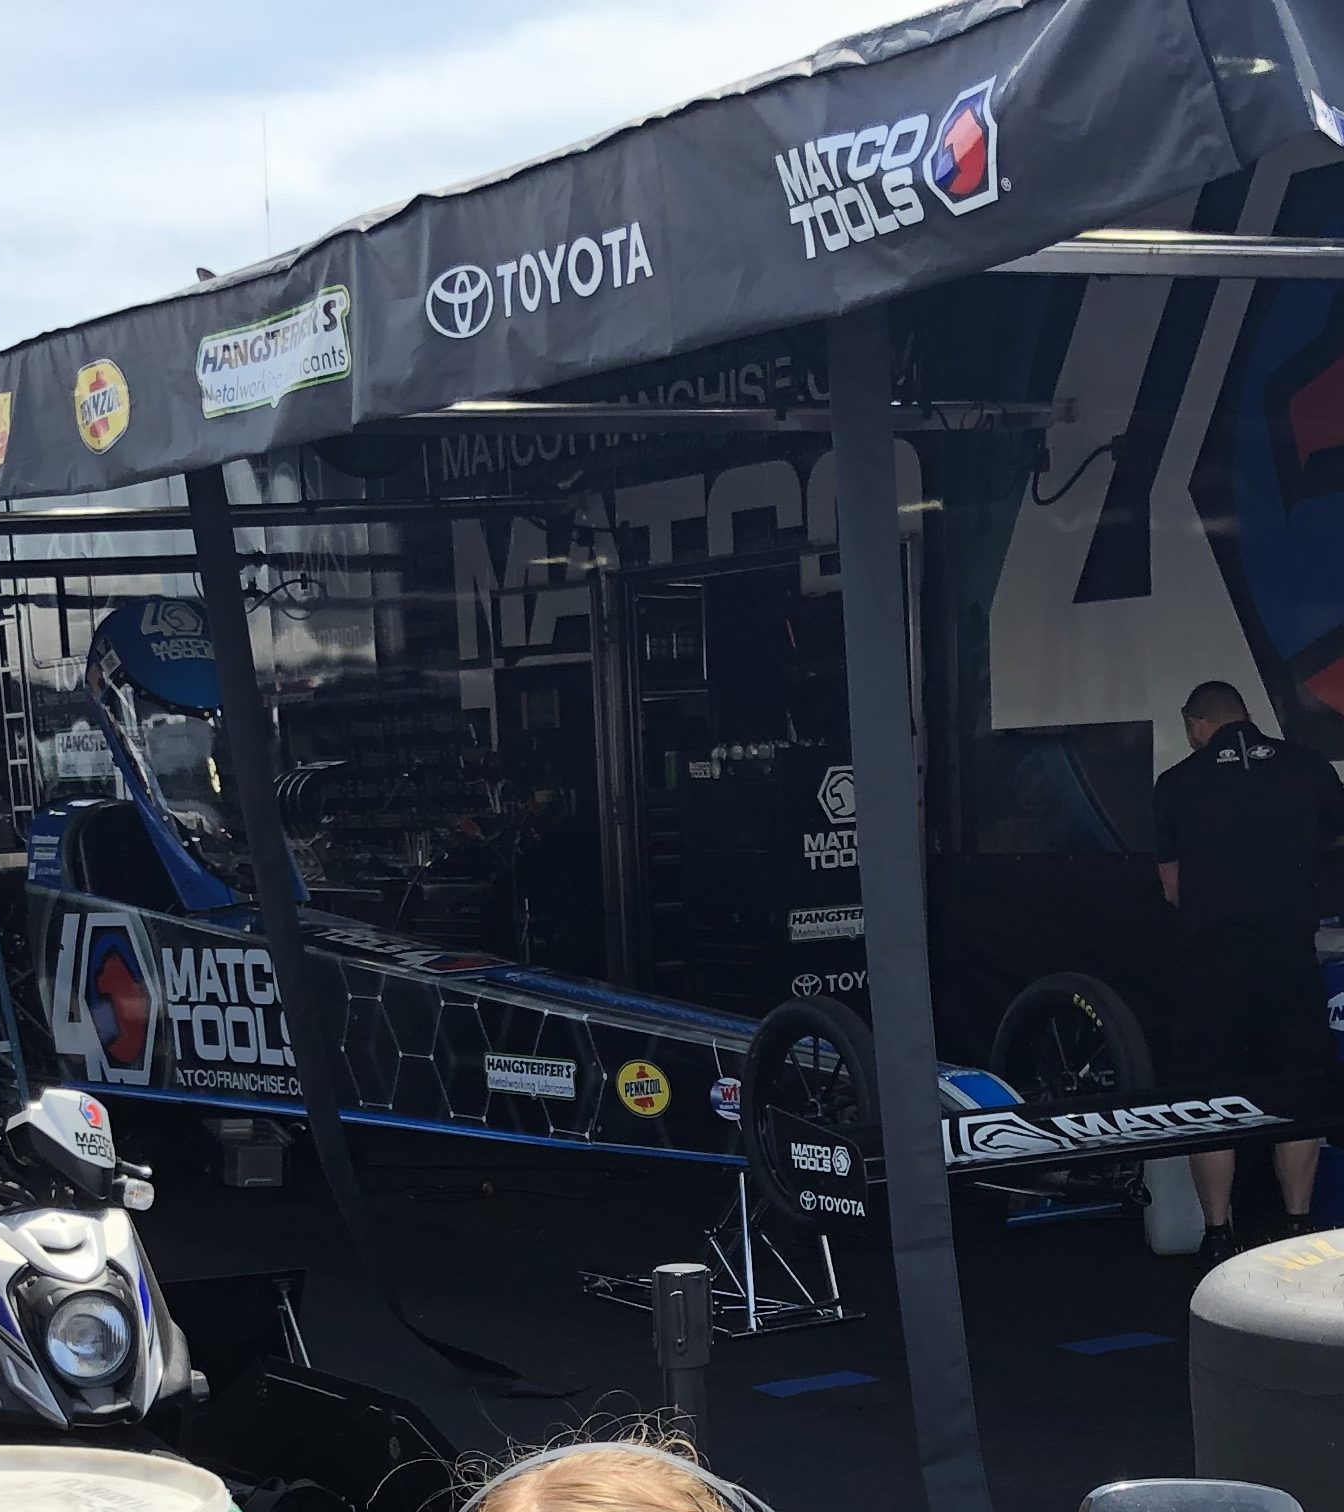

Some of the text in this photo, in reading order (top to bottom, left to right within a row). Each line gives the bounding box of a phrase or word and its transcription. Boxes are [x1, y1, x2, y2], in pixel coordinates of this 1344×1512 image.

[775, 114, 930, 207] MATCO
[789, 172, 925, 259] TOOLS
[496, 221, 654, 318] TOYOTA
[161, 948, 284, 1004] MATC
[486, 1058, 573, 1079] HANGSTERFER'S
[624, 1078, 664, 1098] PENNZOIL
[1051, 1095, 1265, 1144] MATCO
[791, 1143, 831, 1160] MATCO
[792, 1155, 832, 1173] TOOLS
[818, 1195, 866, 1217] TOYOTA
